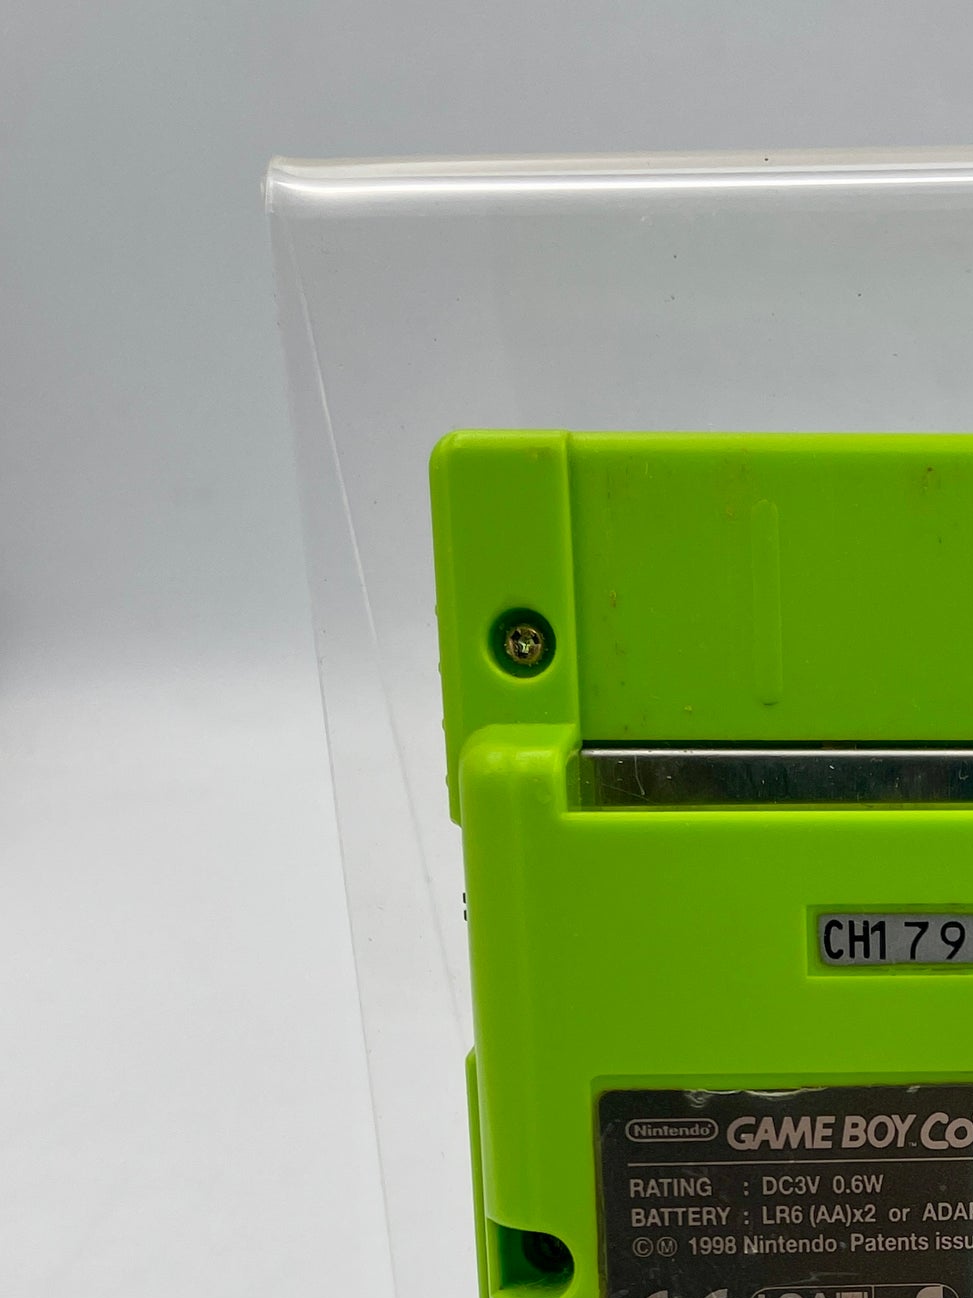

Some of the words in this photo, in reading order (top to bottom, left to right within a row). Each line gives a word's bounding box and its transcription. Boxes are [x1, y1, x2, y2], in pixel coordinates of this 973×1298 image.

[633, 1123, 709, 1138] Nintendo
[727, 1116, 835, 1150] GAME
[629, 1178, 712, 1197] RATING
[763, 1176, 820, 1195] DC3V
[833, 1175, 884, 1194] 0.6W
[632, 1207, 731, 1227] BATTERY
[763, 1205, 803, 1224] LR6
[811, 1204, 876, 1228] (AA)x2
[889, 1207, 910, 1221] or
[689, 1236, 736, 1254] 1998
[744, 1234, 837, 1254] Nintendo
[851, 1233, 928, 1252] Patents
